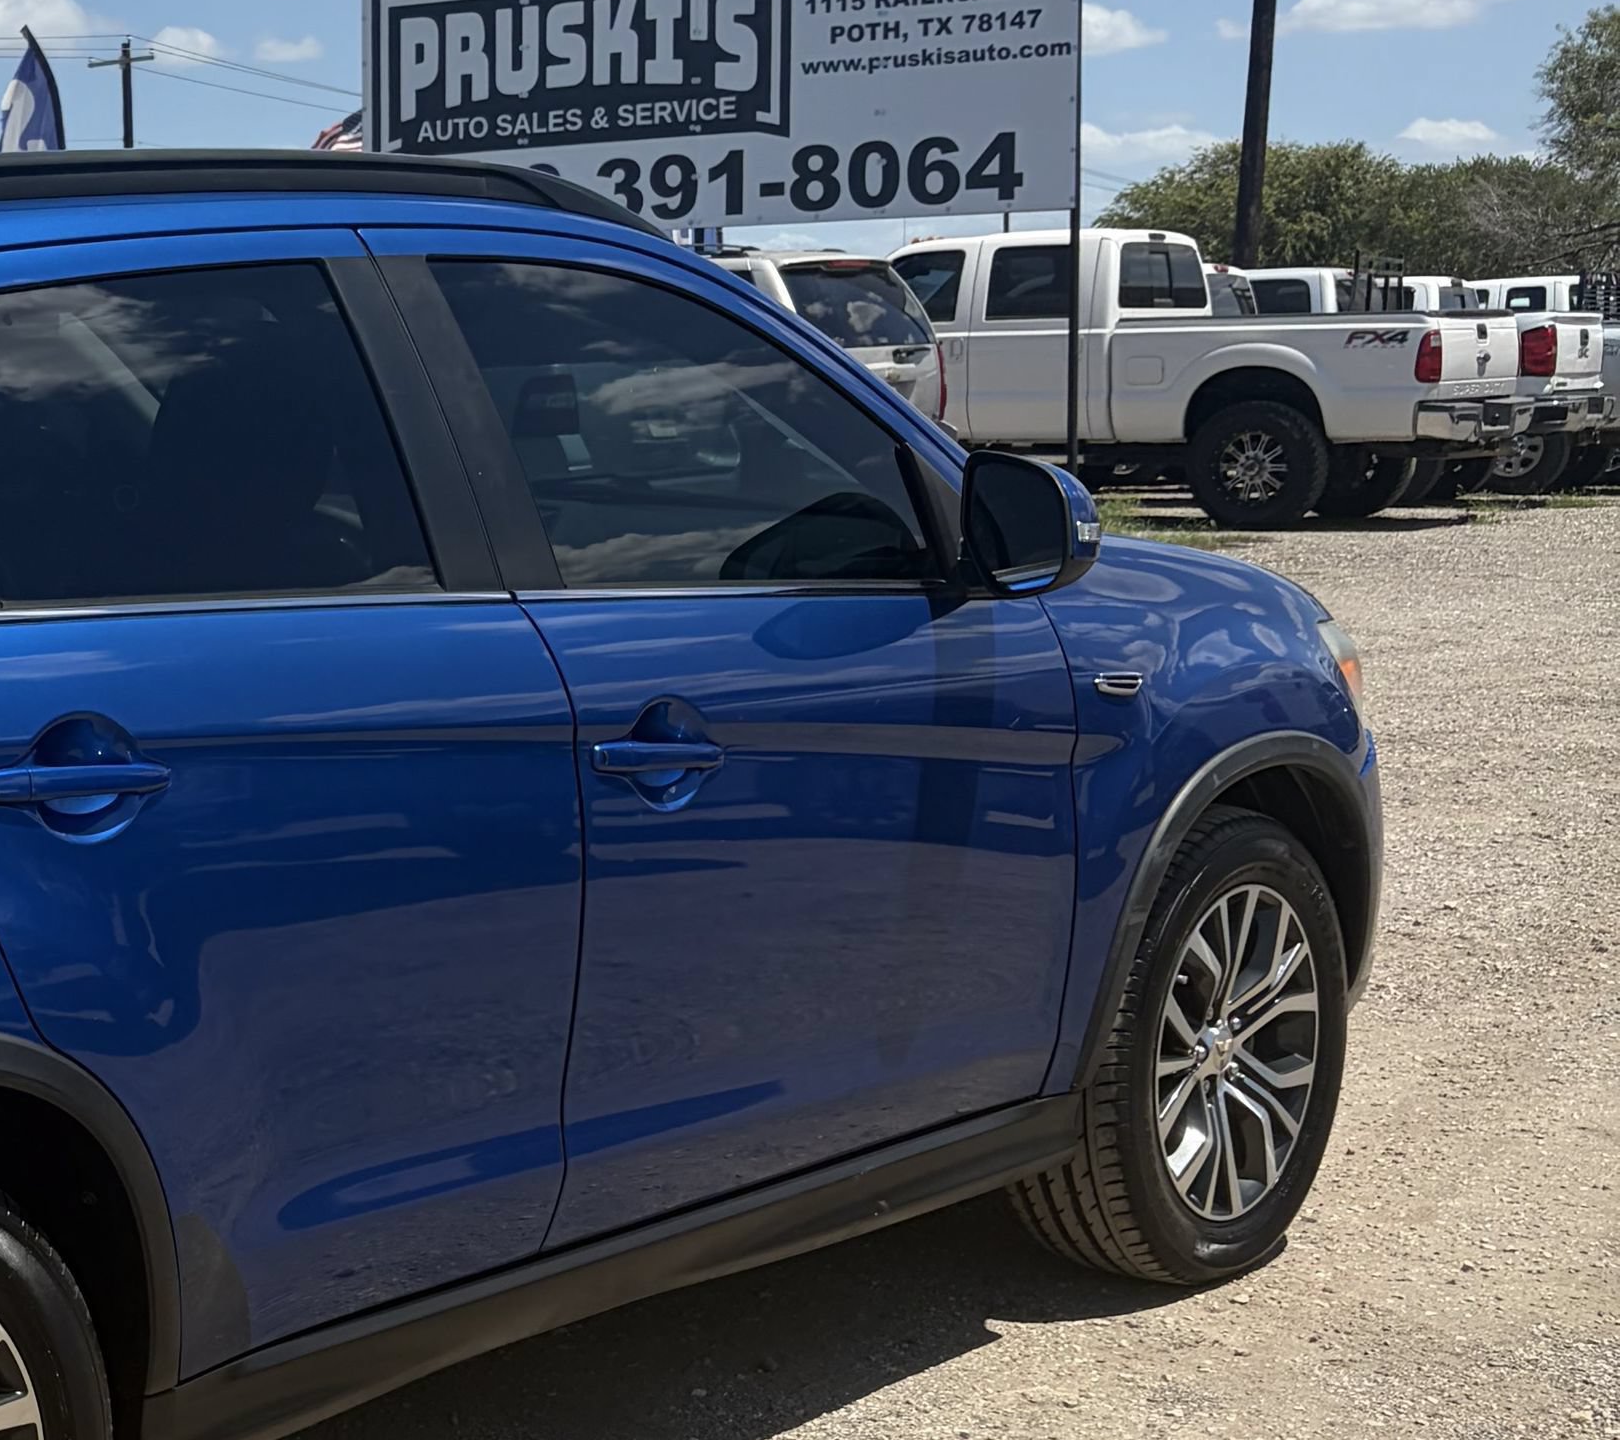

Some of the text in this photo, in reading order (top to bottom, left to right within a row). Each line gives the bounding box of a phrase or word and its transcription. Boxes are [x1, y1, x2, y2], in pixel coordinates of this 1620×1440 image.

[830, 8, 1043, 45] POTH, TX 78147
[801, 40, 1072, 75] www.pruskisauto.com
[417, 96, 738, 143] AUTO SALES & SERVICE
[1344, 330, 1411, 345] FX4
